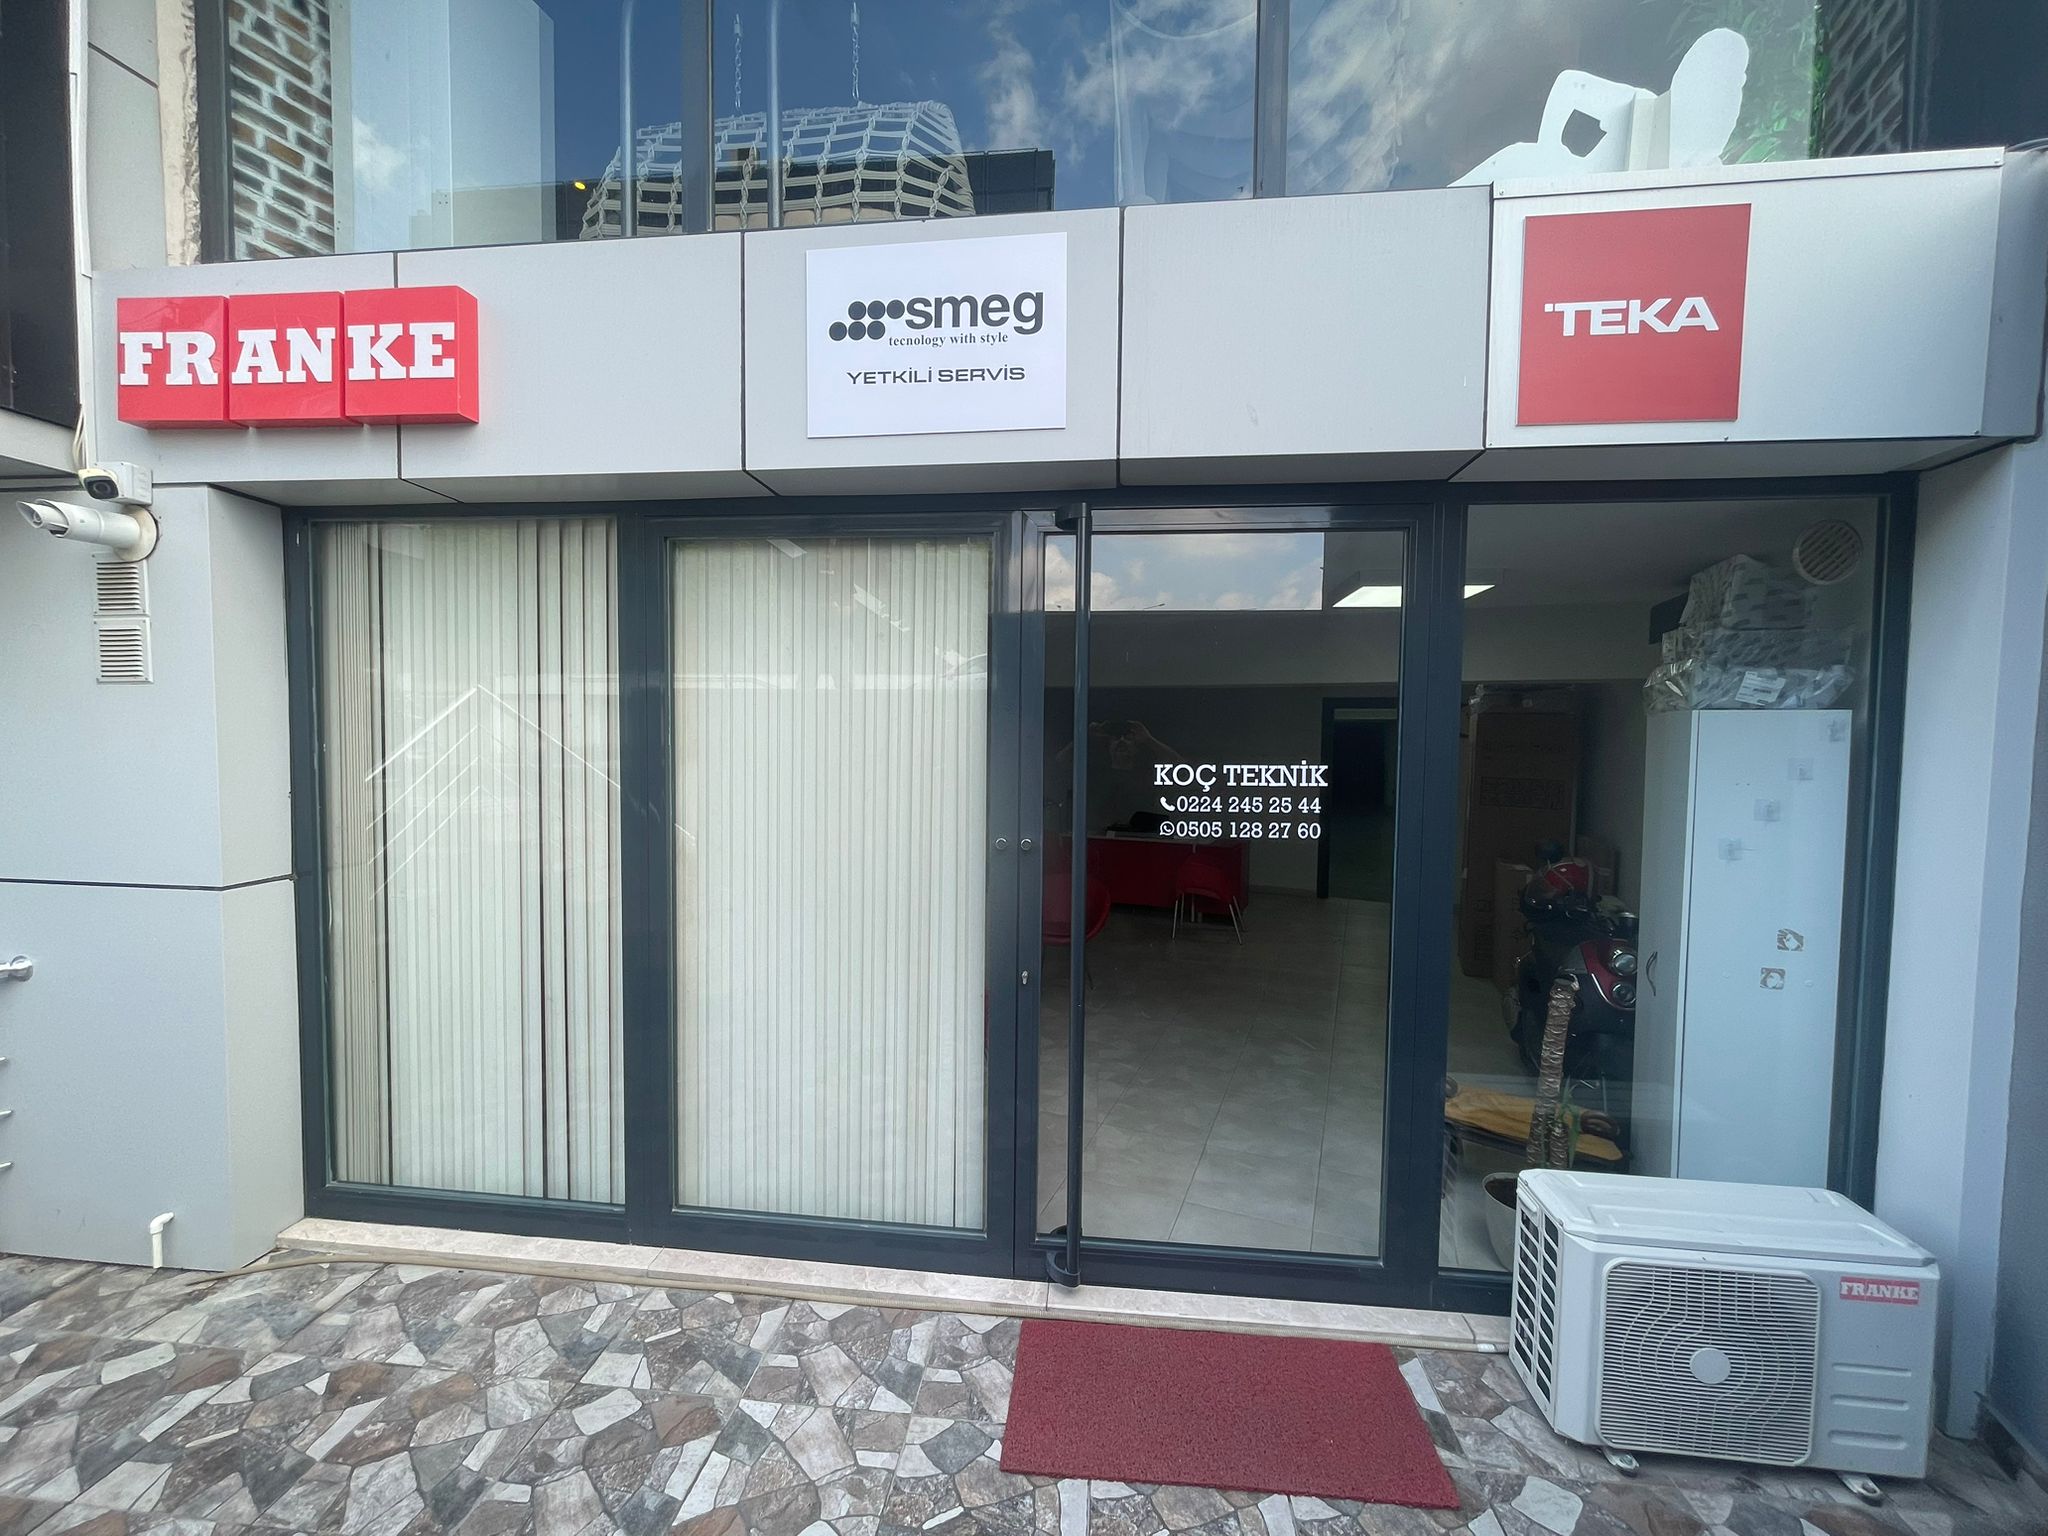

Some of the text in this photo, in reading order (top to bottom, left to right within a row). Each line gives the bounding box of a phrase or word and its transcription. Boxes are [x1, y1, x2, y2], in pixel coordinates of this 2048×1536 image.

[905, 291, 1044, 336] smeg
[1544, 297, 1720, 337] TEKA
[888, 332, 1008, 348] tecnology with style
[119, 321, 455, 386] FRANKE
[847, 364, 1025, 385] YETKİLİ SERVİS
[1153, 760, 1329, 792] KOÇ TEKNİK
[1176, 795, 1321, 814] 0224 245 25 44
[1176, 820, 1321, 839] 0505 128 27 60
[1840, 1281, 1919, 1300] FRANKE
